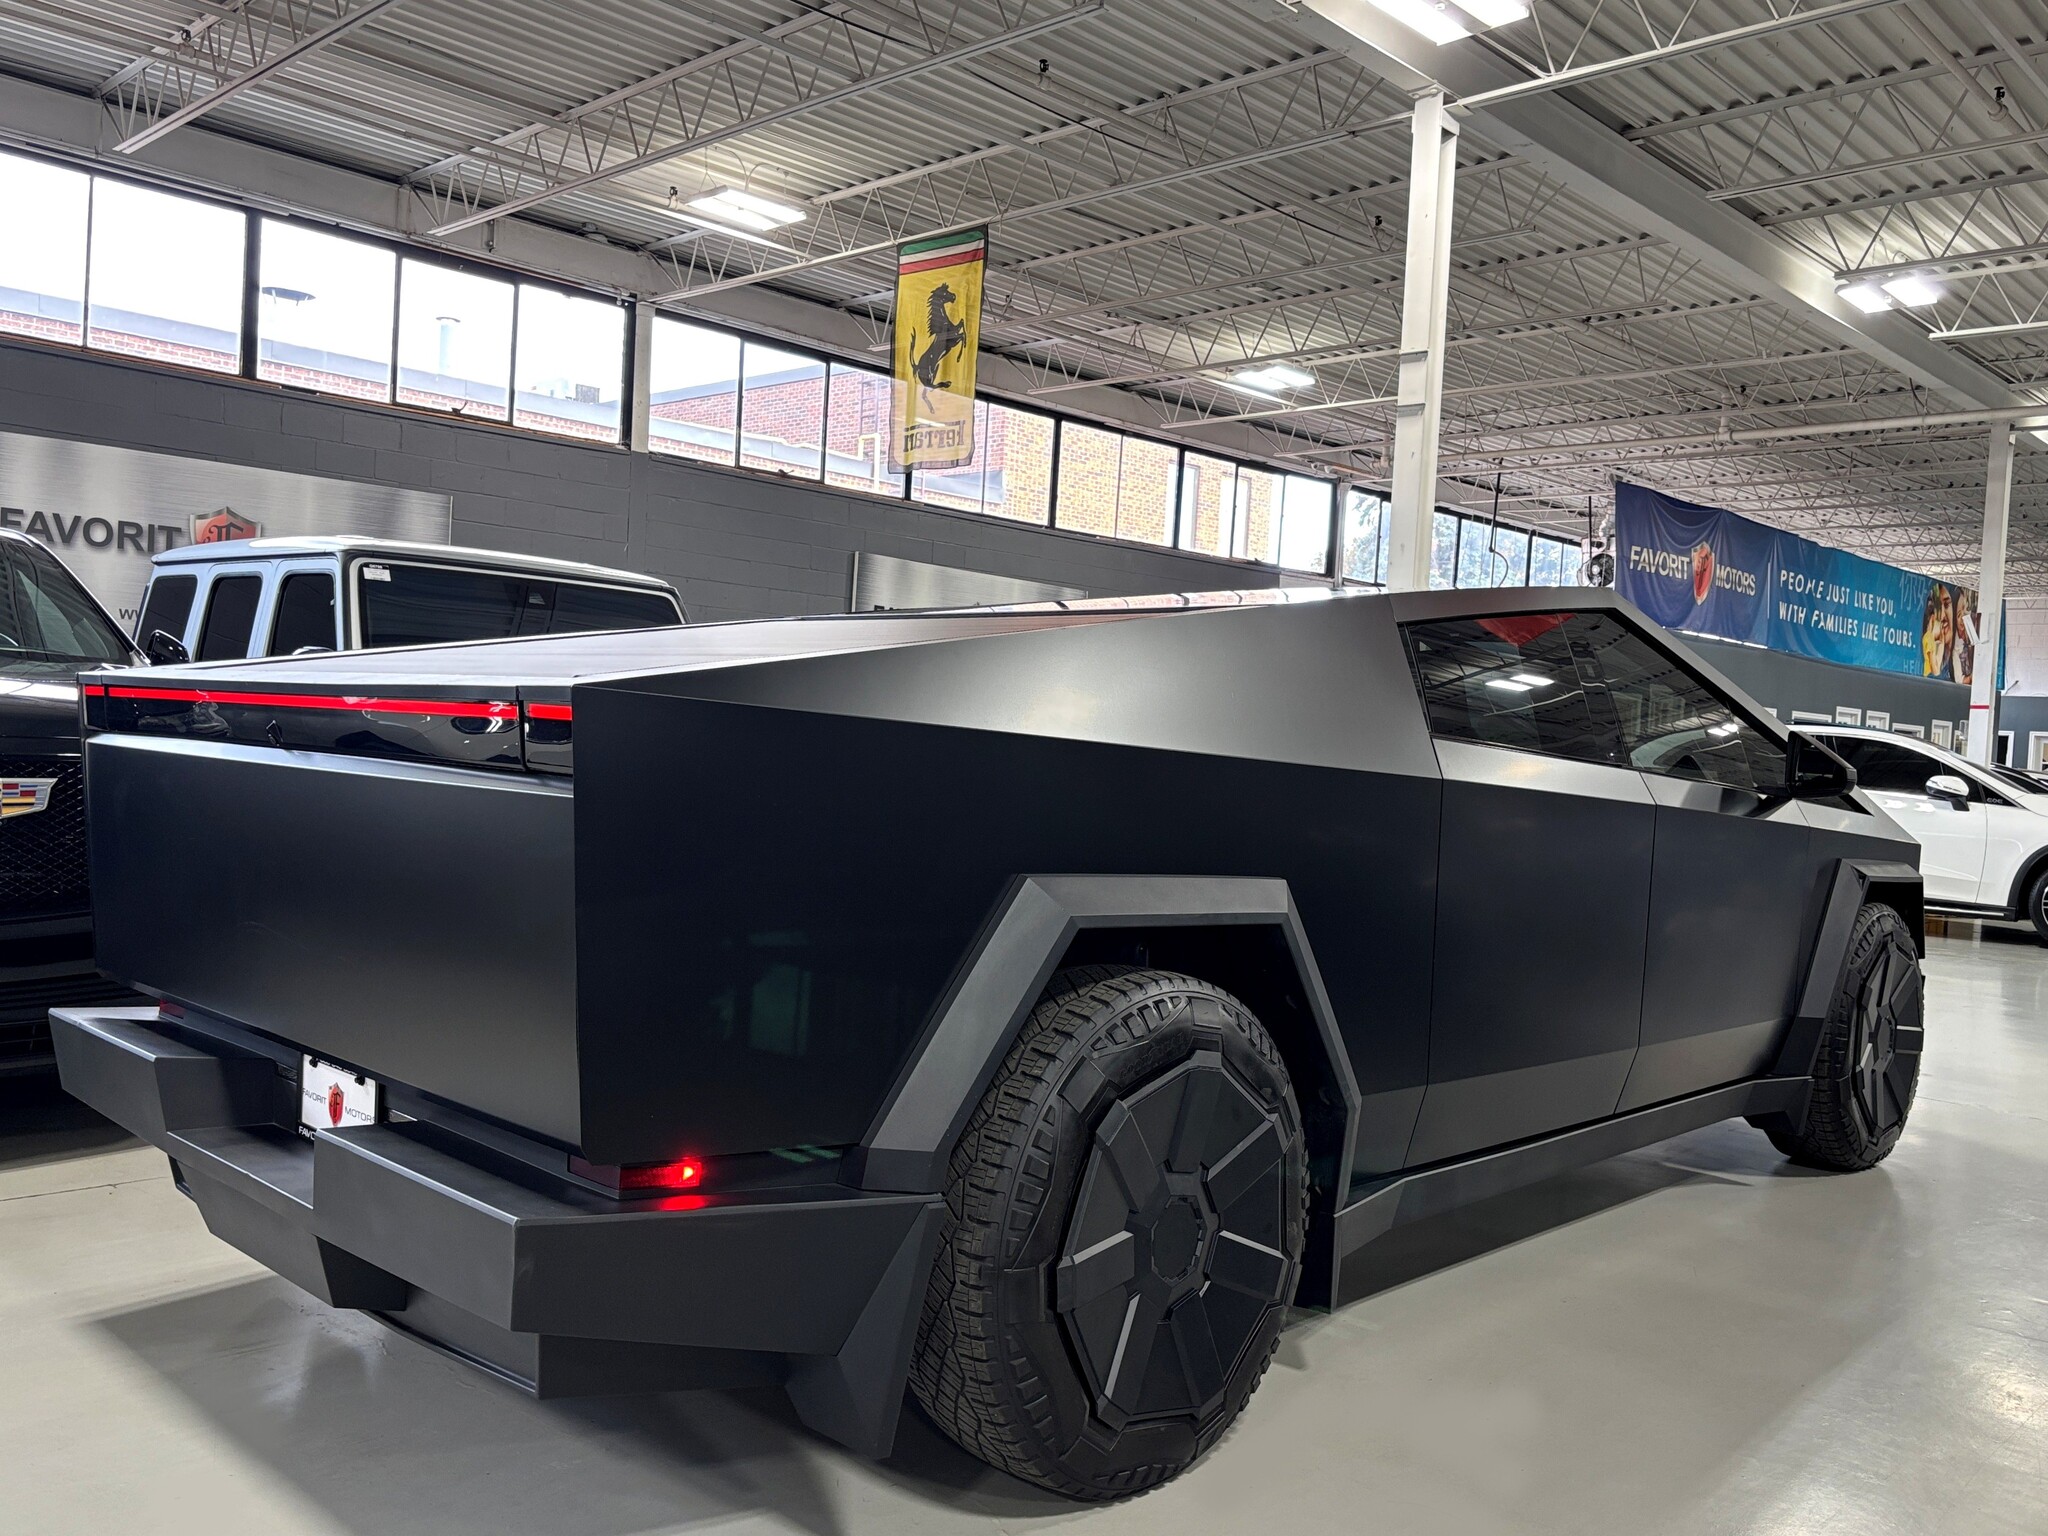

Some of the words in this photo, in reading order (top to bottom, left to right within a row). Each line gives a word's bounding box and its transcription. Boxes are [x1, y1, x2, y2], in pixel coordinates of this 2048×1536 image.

[0, 507, 182, 553] FAVORIT
[1629, 545, 1689, 580] FAVORIT
[1715, 564, 1756, 597] MOTORS
[1826, 583, 1850, 606] JUST
[1854, 590, 1873, 611] LIKE
[1875, 595, 1897, 619] YOU,
[1779, 601, 1807, 625] WITH
[1811, 609, 1858, 637] FAMILIES
[1861, 622, 1879, 641] LIKE
[1882, 626, 1916, 649] YOURS.
[302, 1088, 326, 1104] FAVORIT
